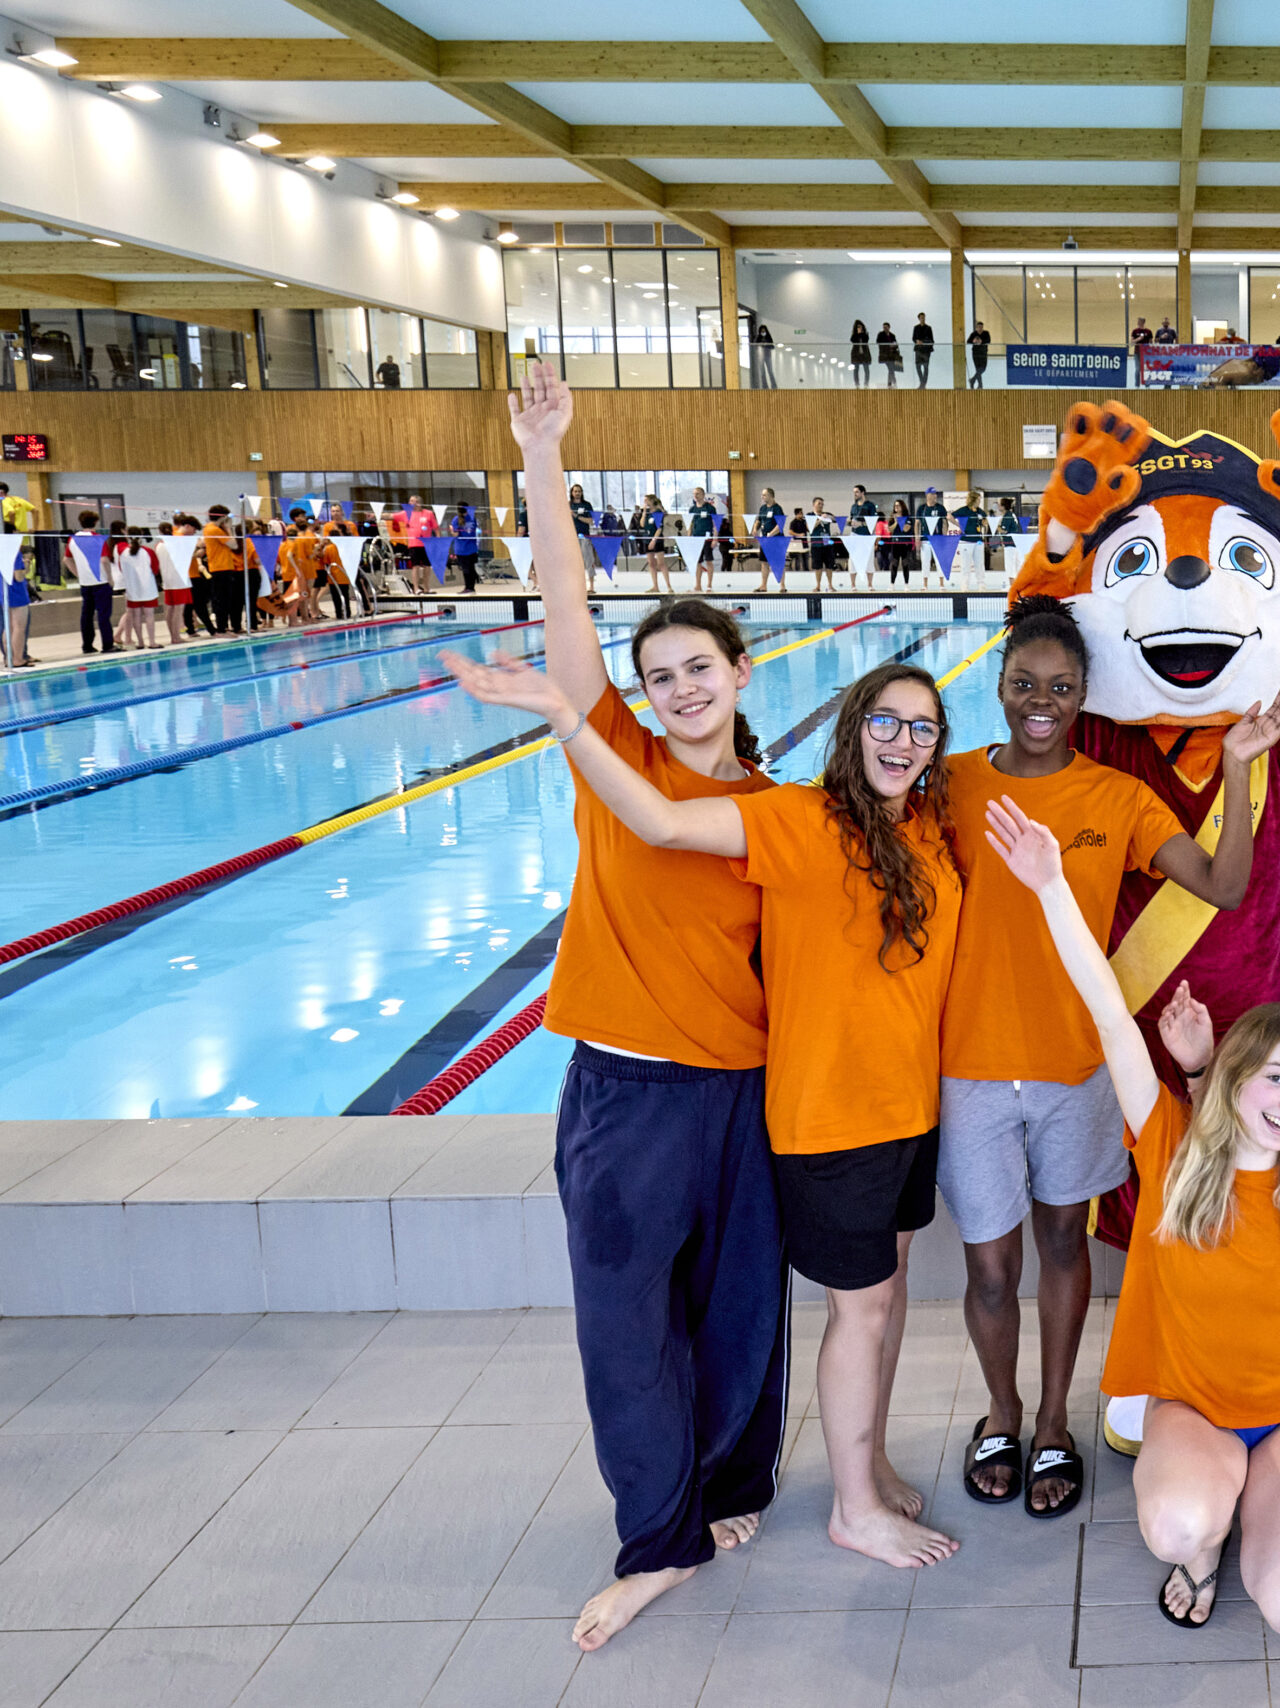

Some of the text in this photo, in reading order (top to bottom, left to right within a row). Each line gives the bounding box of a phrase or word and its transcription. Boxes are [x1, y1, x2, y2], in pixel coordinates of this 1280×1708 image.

[1144, 345, 1232, 356] CHAMPIONNAT
[1235, 347, 1250, 357] DE
[1034, 369, 1043, 377] LE
[980, 1437, 1008, 1451] NIKE
[1039, 1450, 1066, 1462] NIKE
